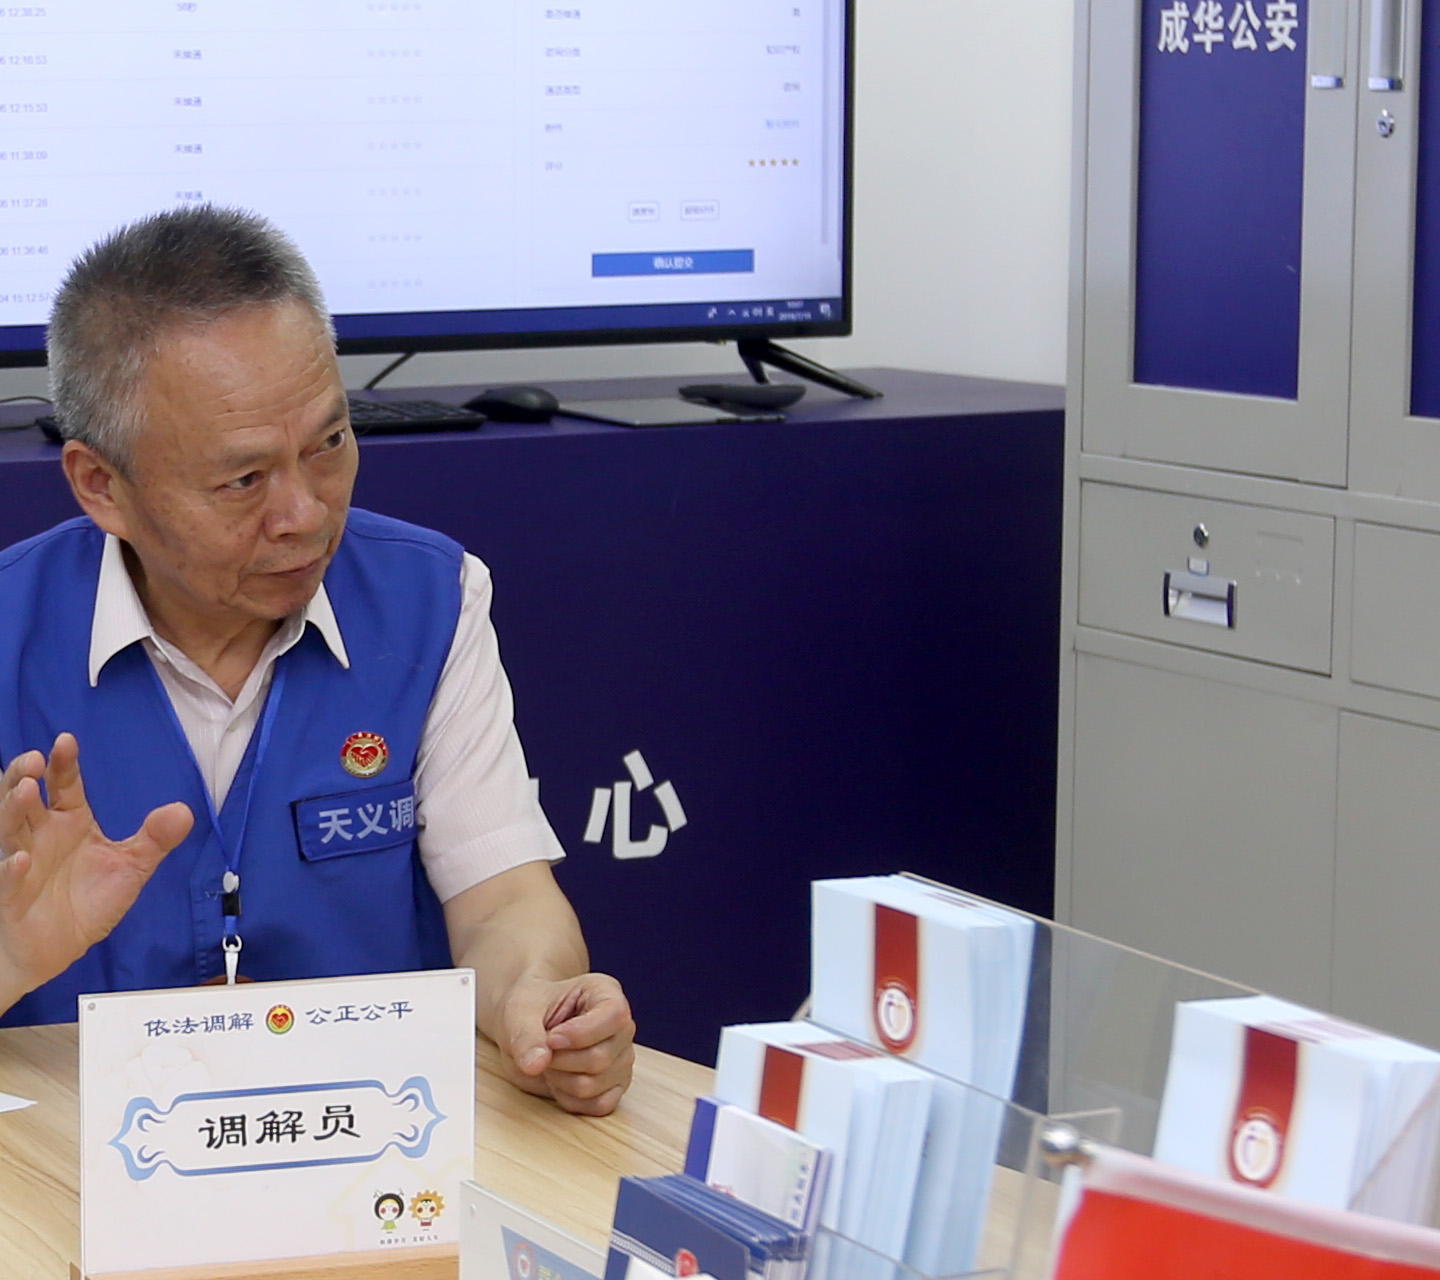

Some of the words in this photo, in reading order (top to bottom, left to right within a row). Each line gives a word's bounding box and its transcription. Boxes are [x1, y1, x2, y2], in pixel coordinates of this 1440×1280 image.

[583, 749, 688, 859] 心
[143, 1012, 254, 1038] 依法调解
[305, 1000, 414, 1026] 公正公平
[198, 1104, 362, 1151] 调解员
